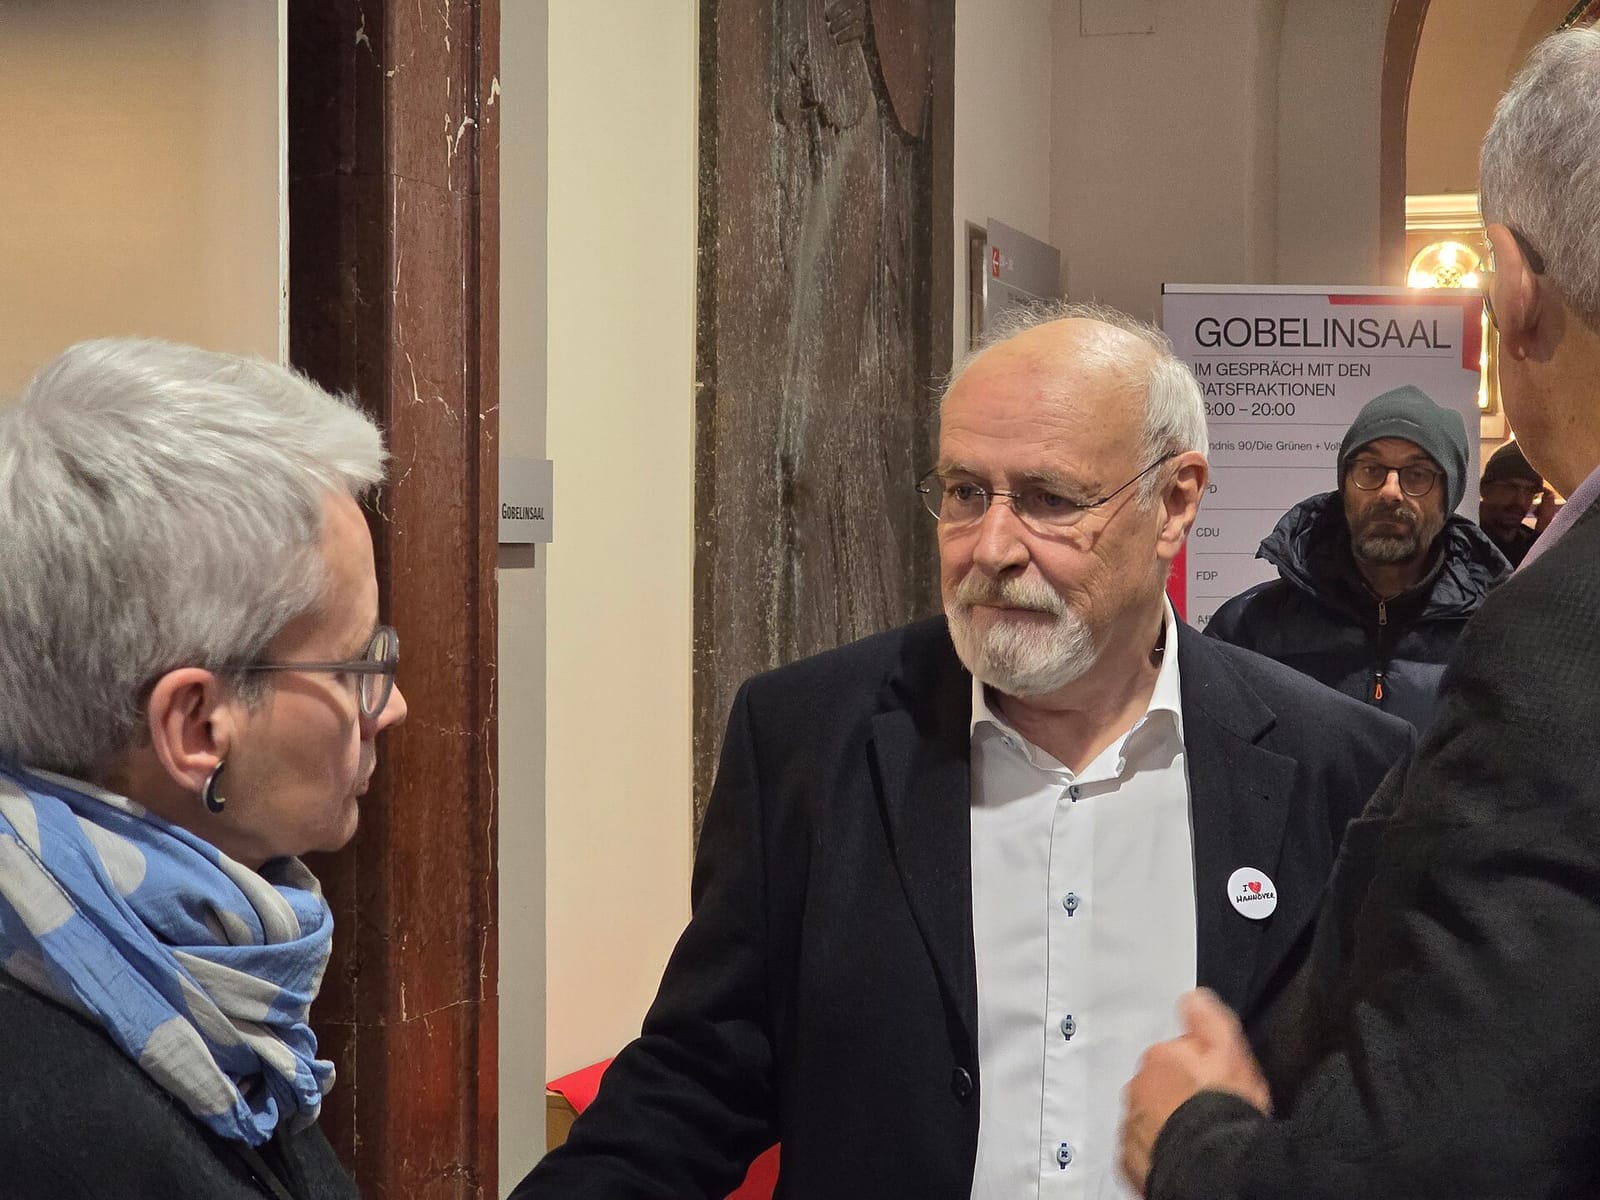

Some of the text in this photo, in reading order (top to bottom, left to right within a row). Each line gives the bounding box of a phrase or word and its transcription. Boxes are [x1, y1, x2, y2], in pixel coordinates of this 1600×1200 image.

[1195, 317, 1452, 349] GOBELINSAAL
[1194, 361, 1371, 377] IM GESPRÄCH MIT DEN
[1203, 402, 1235, 416] 8:00
[1251, 402, 1296, 416] 20:00
[1208, 440, 1235, 450] ndnis
[1238, 441, 1273, 451] 90/Die
[1275, 440, 1312, 450] Grünen
[1323, 441, 1341, 450] Vol
[1196, 527, 1220, 537] CDU
[1196, 571, 1218, 580] FDP
[1242, 884, 1248, 892] I
[1235, 892, 1275, 903] HANNOVER
